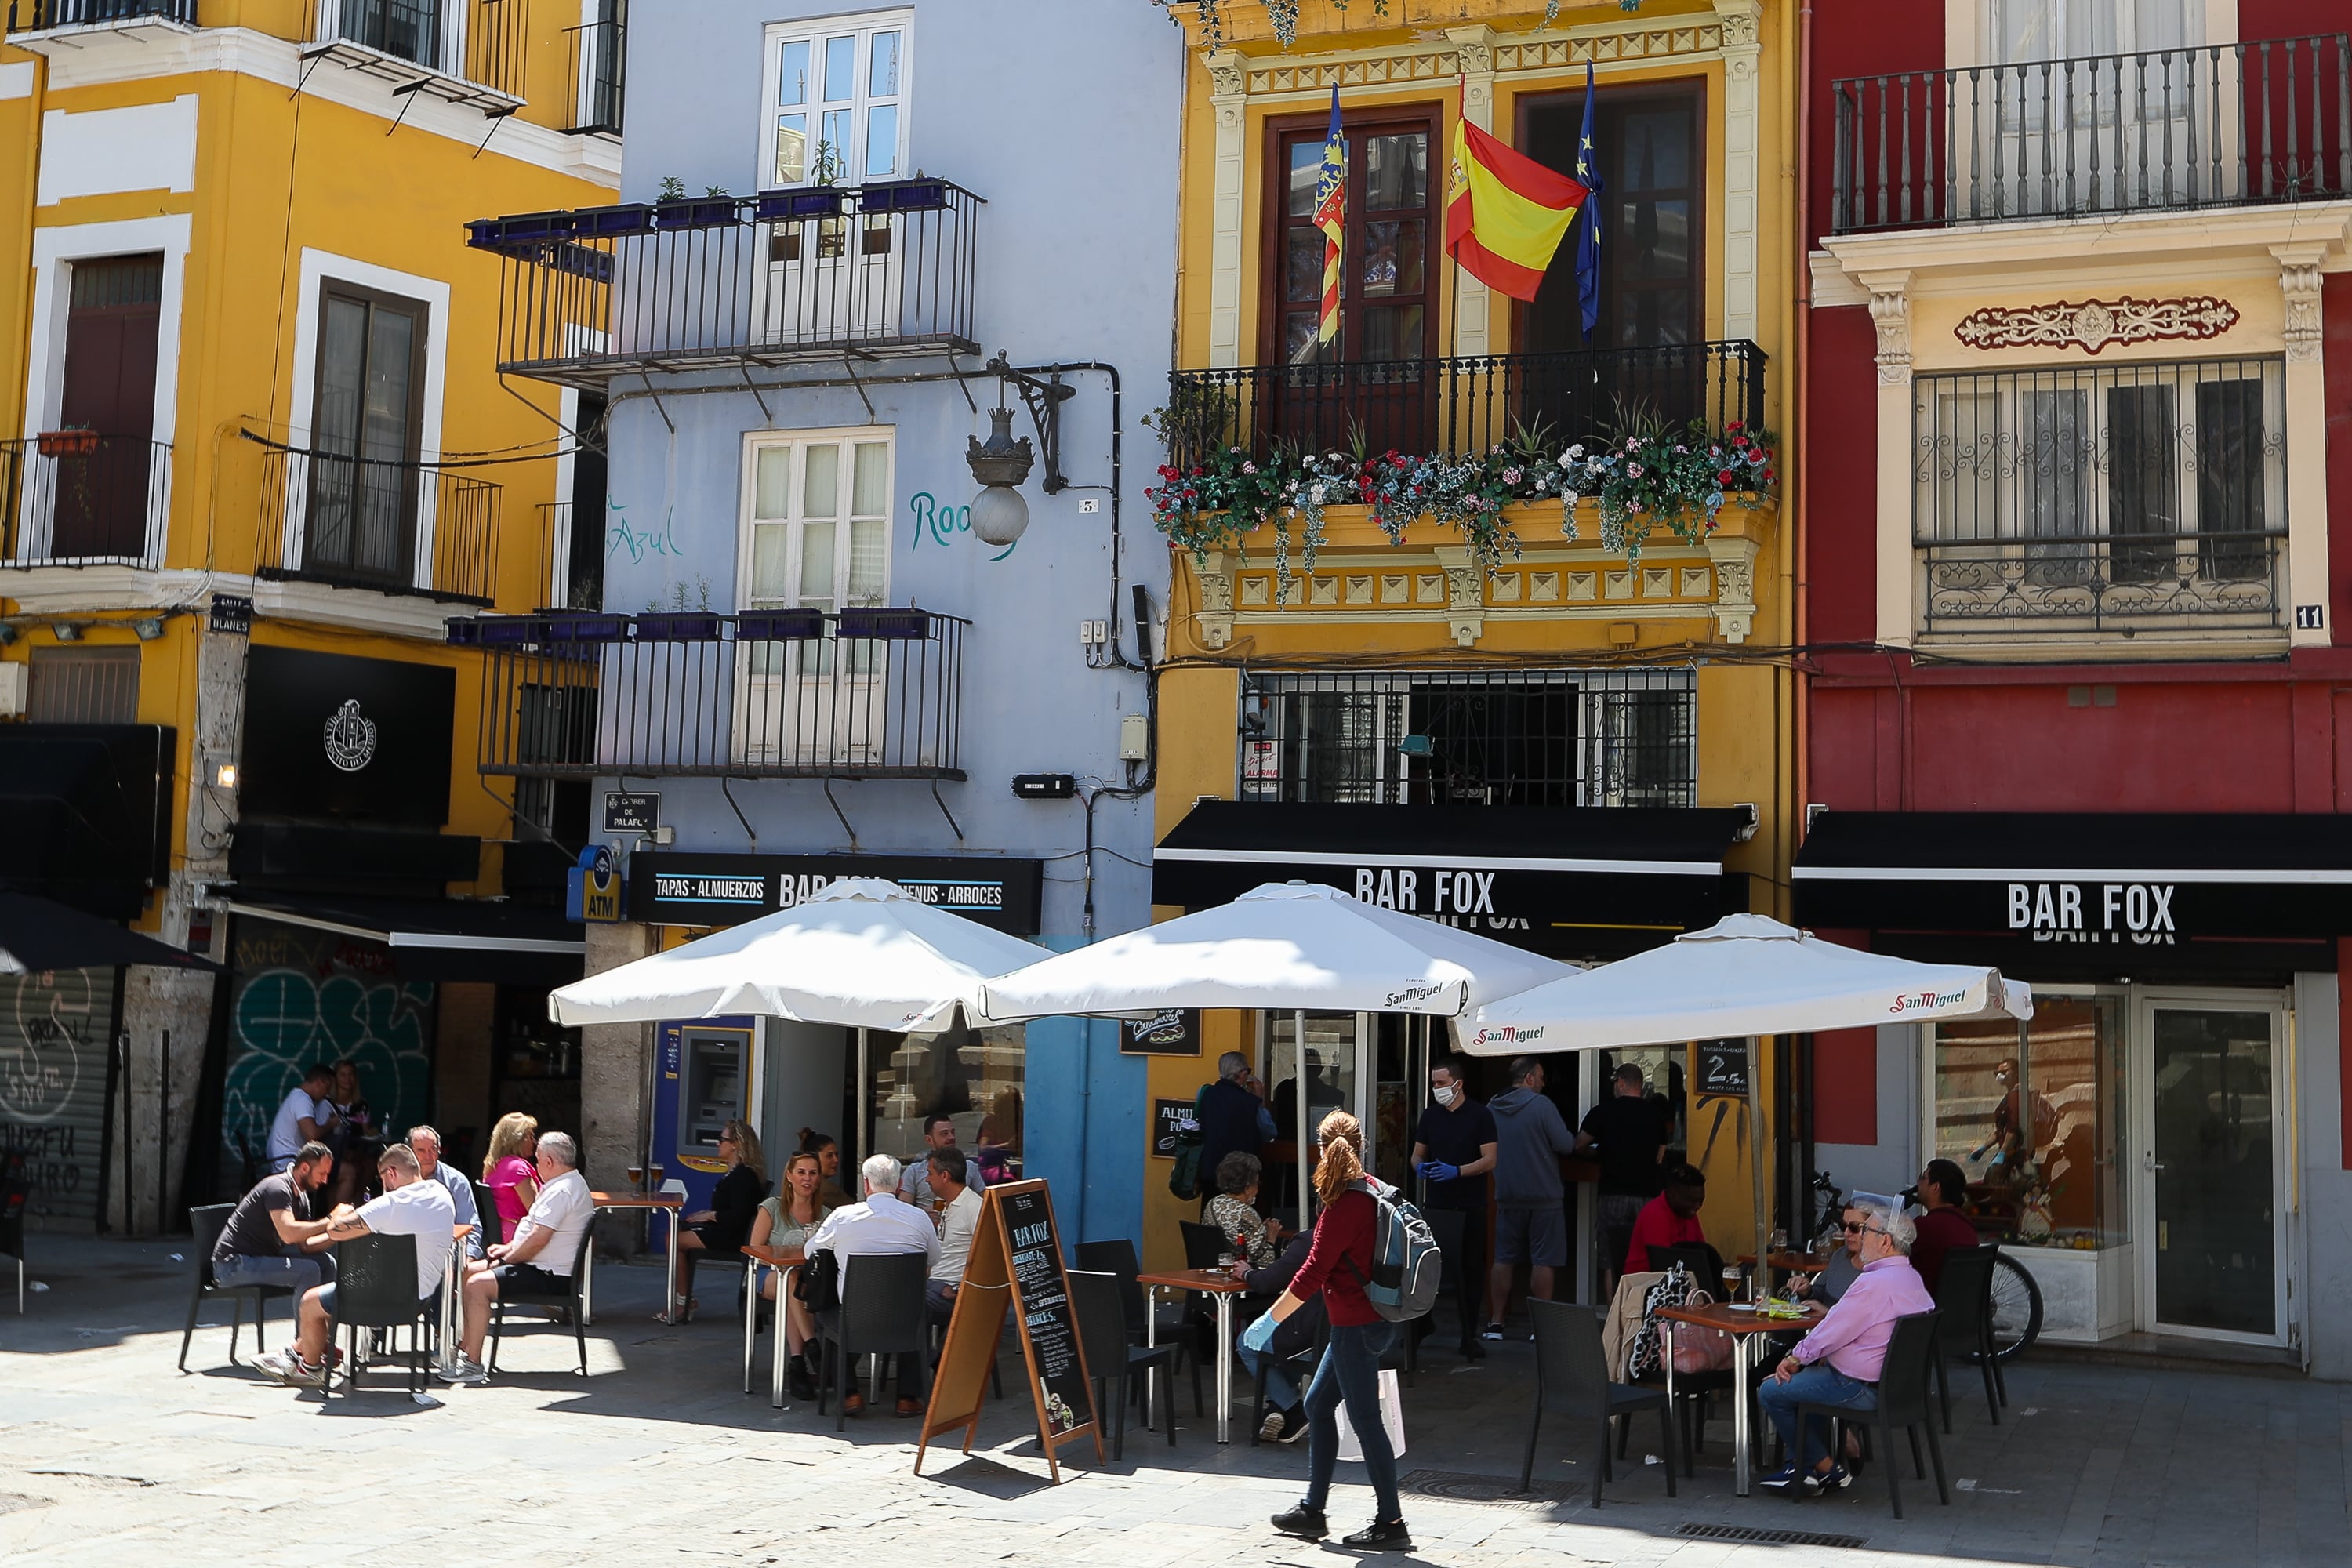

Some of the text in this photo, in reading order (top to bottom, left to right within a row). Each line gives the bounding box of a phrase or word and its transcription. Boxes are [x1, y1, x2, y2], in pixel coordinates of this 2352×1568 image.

[608, 504, 683, 564] Azul
[2299, 607, 2321, 628] 11
[588, 895, 614, 917] ATM
[655, 879, 689, 897] TAPAS
[697, 880, 764, 898] ALMUERZOS
[947, 885, 1003, 905] ARROCES
[1356, 868, 1495, 913] BAR FOX
[2008, 884, 2176, 931] BAR FOX
